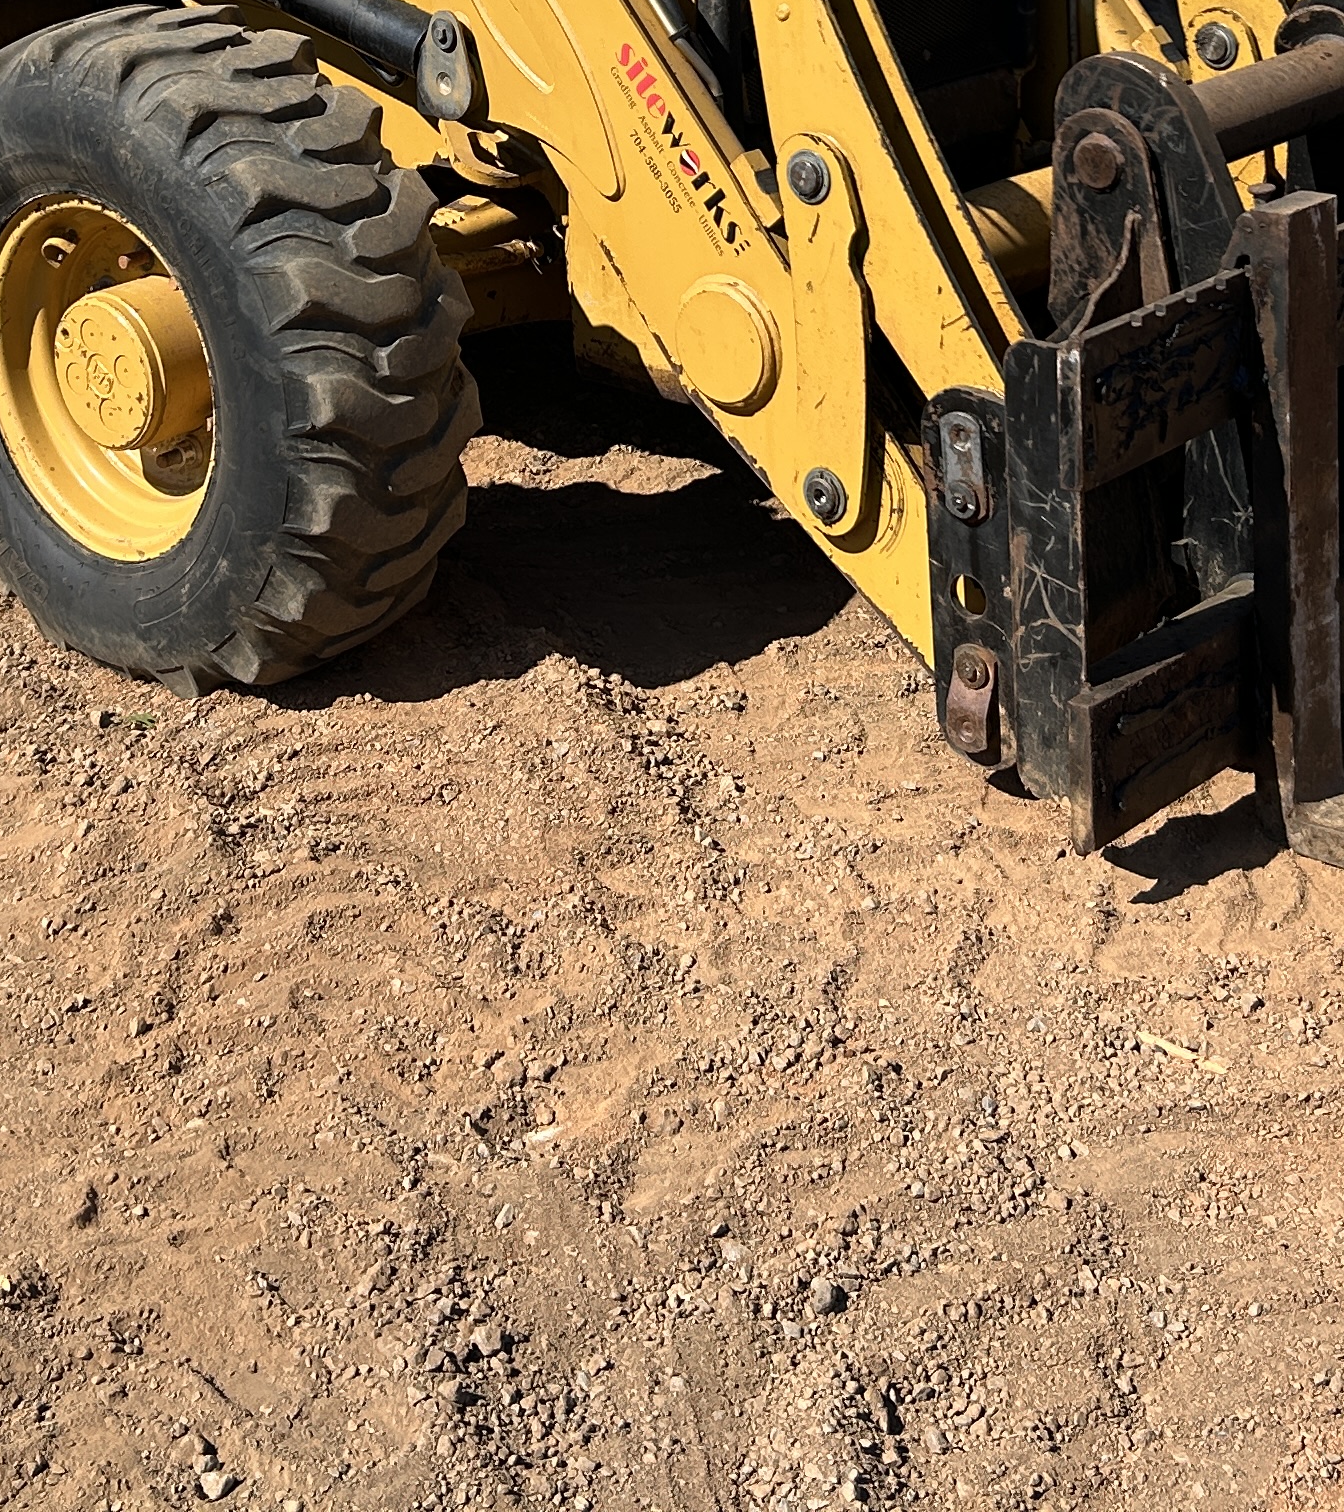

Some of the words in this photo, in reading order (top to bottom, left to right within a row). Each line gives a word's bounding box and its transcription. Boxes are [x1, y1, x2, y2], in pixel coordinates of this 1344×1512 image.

[610, 65, 638, 111] Grading
[637, 114, 665, 156] Asphalt
[666, 159, 697, 209] Concrete
[698, 213, 726, 258] Utilities
